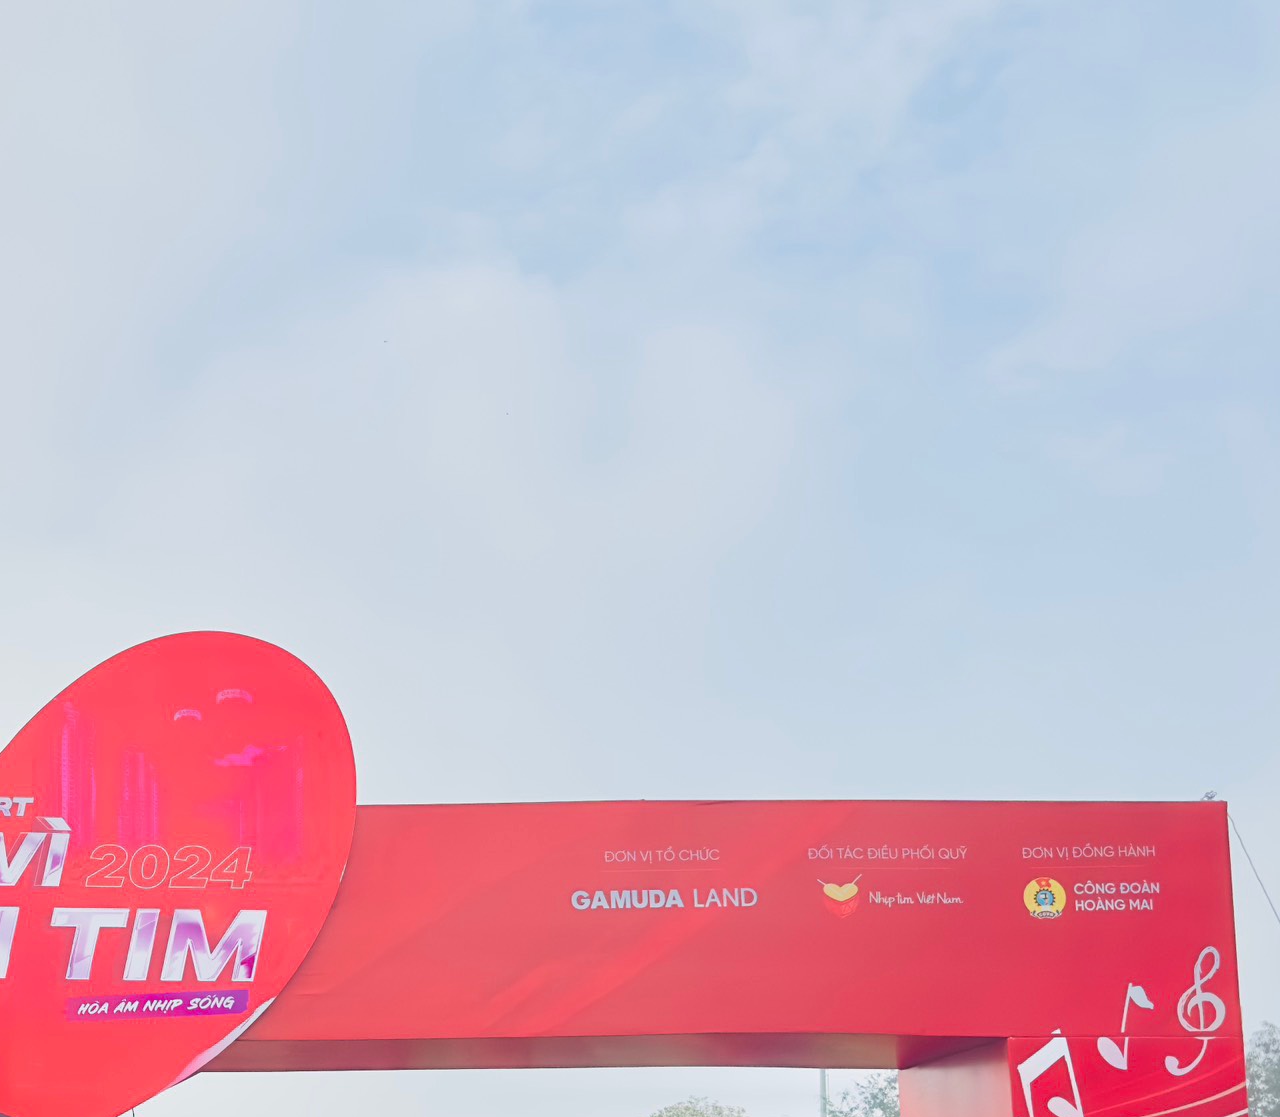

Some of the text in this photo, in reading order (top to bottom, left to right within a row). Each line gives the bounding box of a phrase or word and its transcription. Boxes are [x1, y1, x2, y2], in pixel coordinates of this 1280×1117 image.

[604, 845, 720, 864] ĐƠN VỊ TỔ CHỨC
[808, 844, 968, 861] ĐỐI TÁC ĐIỀU PHỐI QUỸ
[1022, 842, 1155, 861] ĐƠN VỊ ĐỒNG HÀNH
[85, 844, 253, 888] 2024
[1074, 879, 1159, 894] CÔNG ĐOÀN
[571, 887, 758, 909] GAMUDA LAND
[869, 891, 895, 906] Nhịp
[937, 892, 963, 904] Nam
[1076, 895, 1153, 911] HOÀNG MAI
[50, 907, 266, 982] TIM
[77, 993, 236, 1017] HÒA ÂM NHỊP SỐNG
